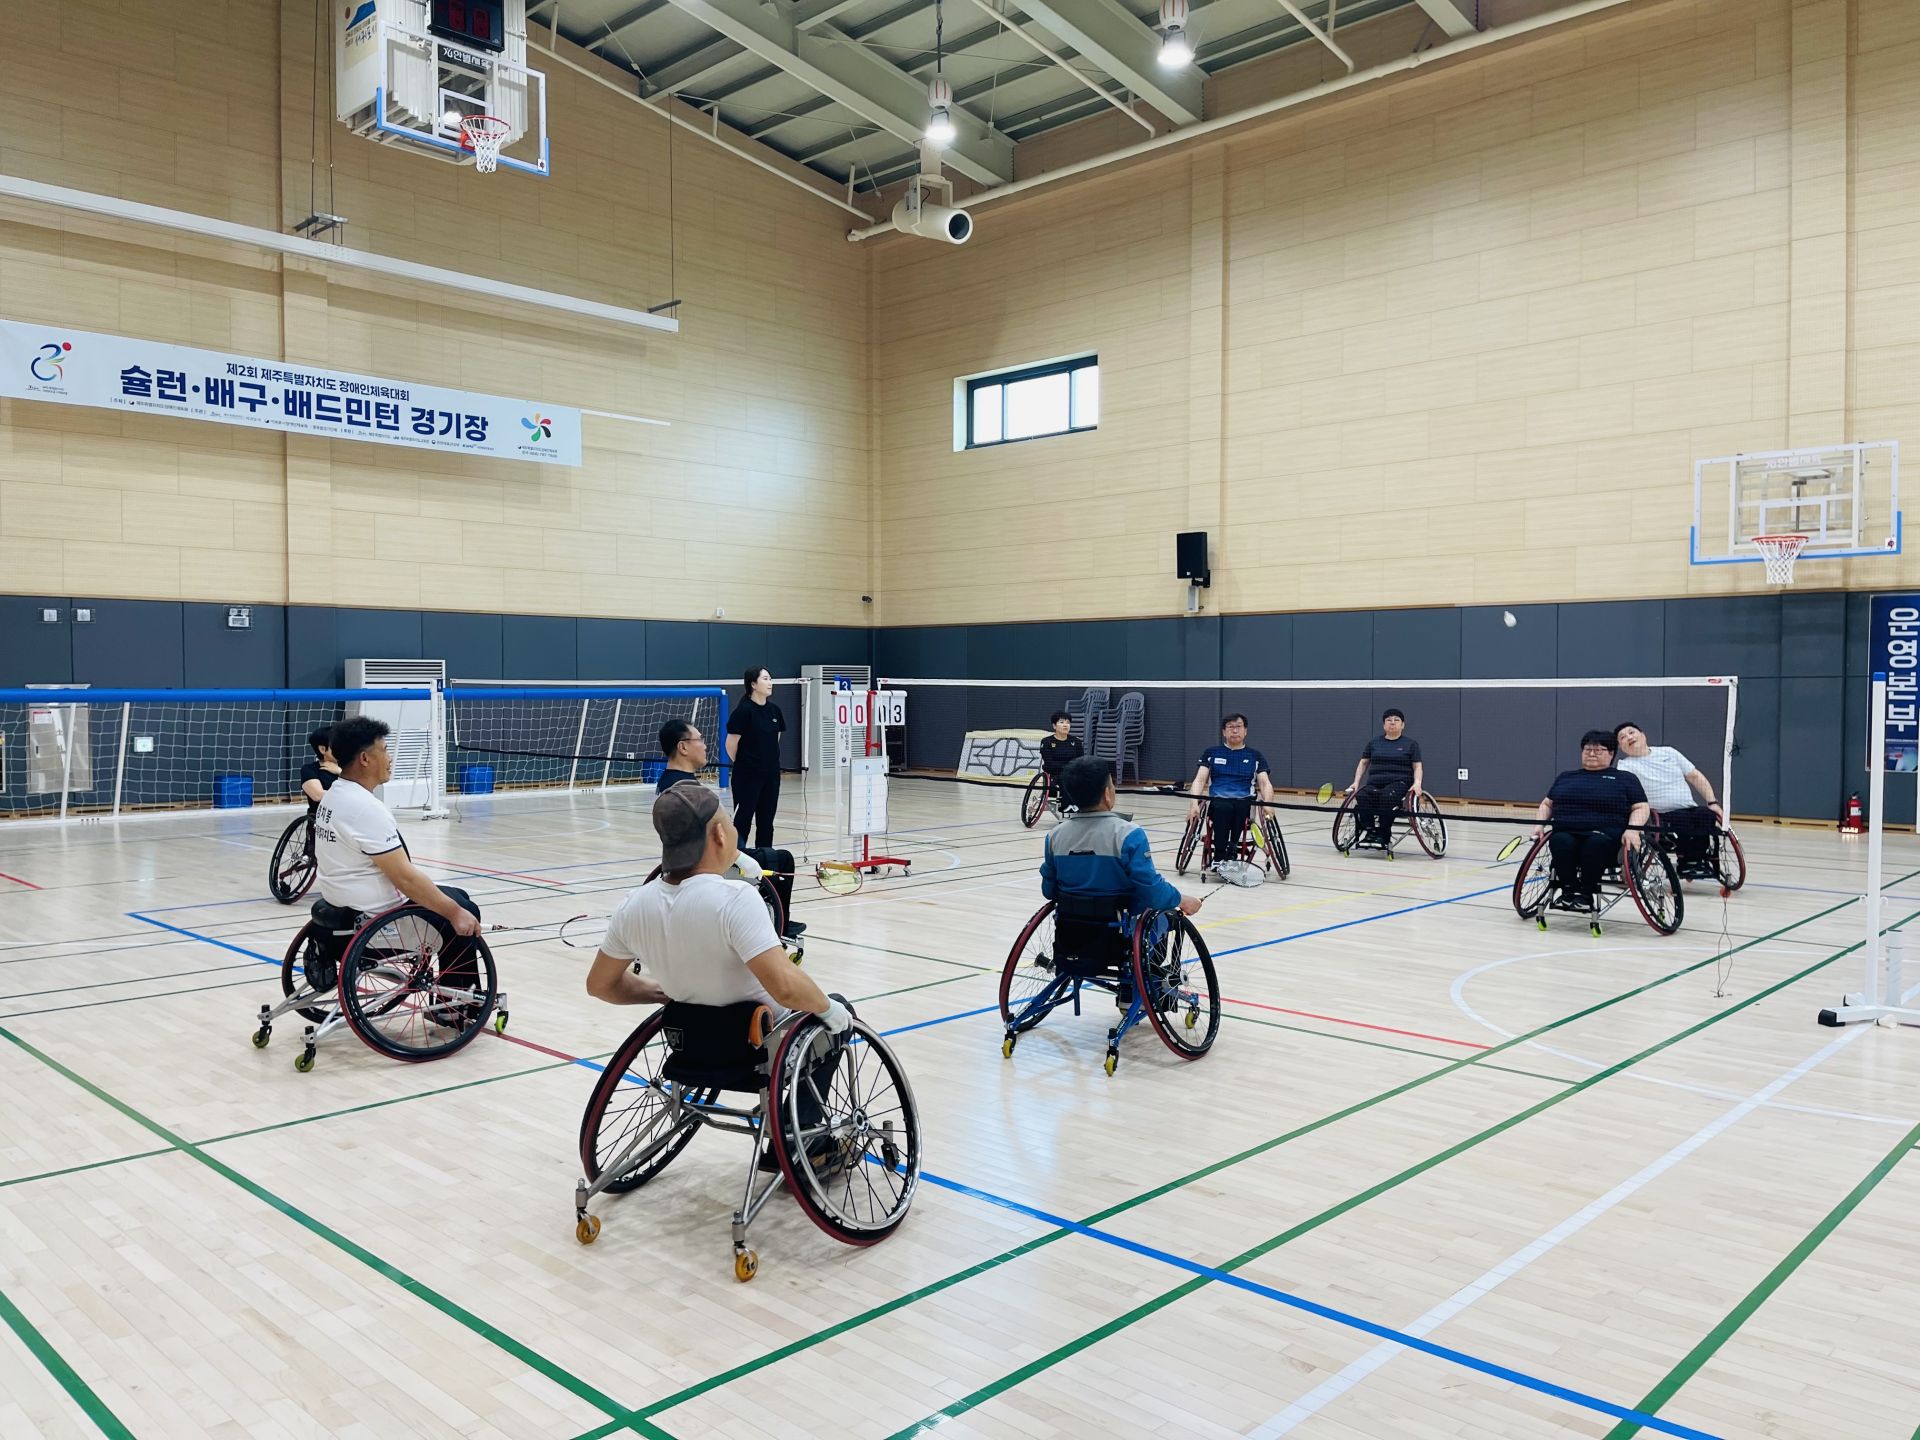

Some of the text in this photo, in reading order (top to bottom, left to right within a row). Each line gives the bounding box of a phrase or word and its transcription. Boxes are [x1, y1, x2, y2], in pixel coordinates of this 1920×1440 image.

[226, 362, 410, 402] 제2회 제주특별자치도 장애인체육대회
[411, 407, 489, 442] 경기장
[1886, 607, 1920, 733] 운영본부
